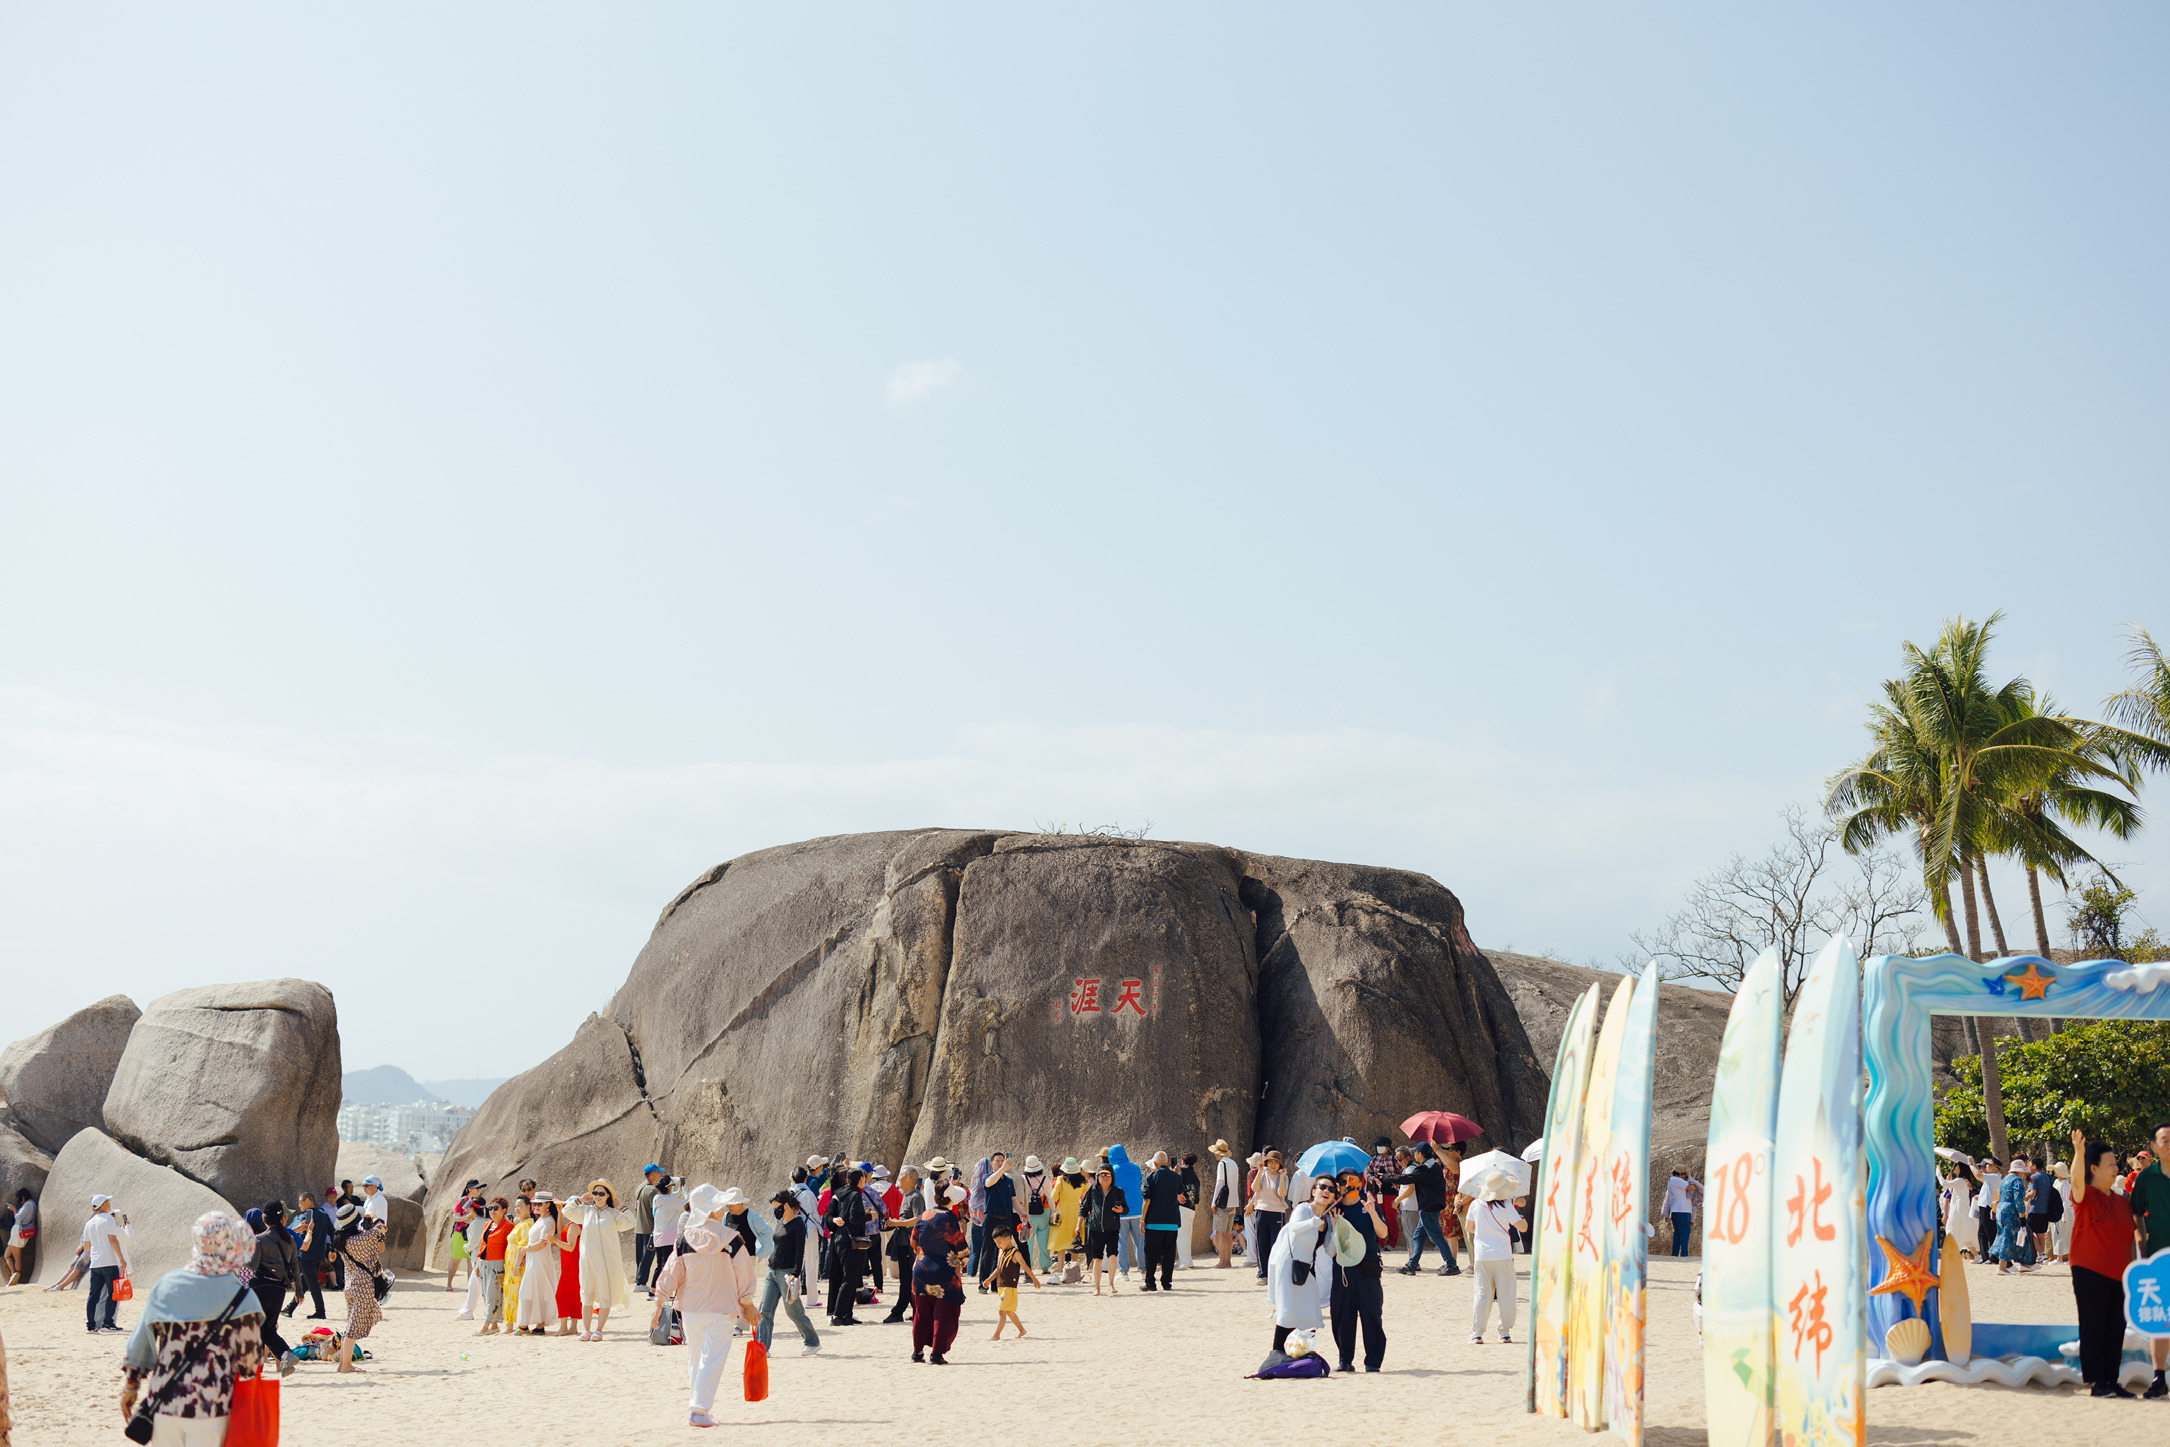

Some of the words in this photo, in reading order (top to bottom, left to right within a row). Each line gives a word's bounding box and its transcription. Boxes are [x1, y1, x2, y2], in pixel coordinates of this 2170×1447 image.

[1544, 1155, 1563, 1234] 天
[1787, 1156, 1836, 1382] 北纬
[2137, 1278, 2162, 1306] 天
